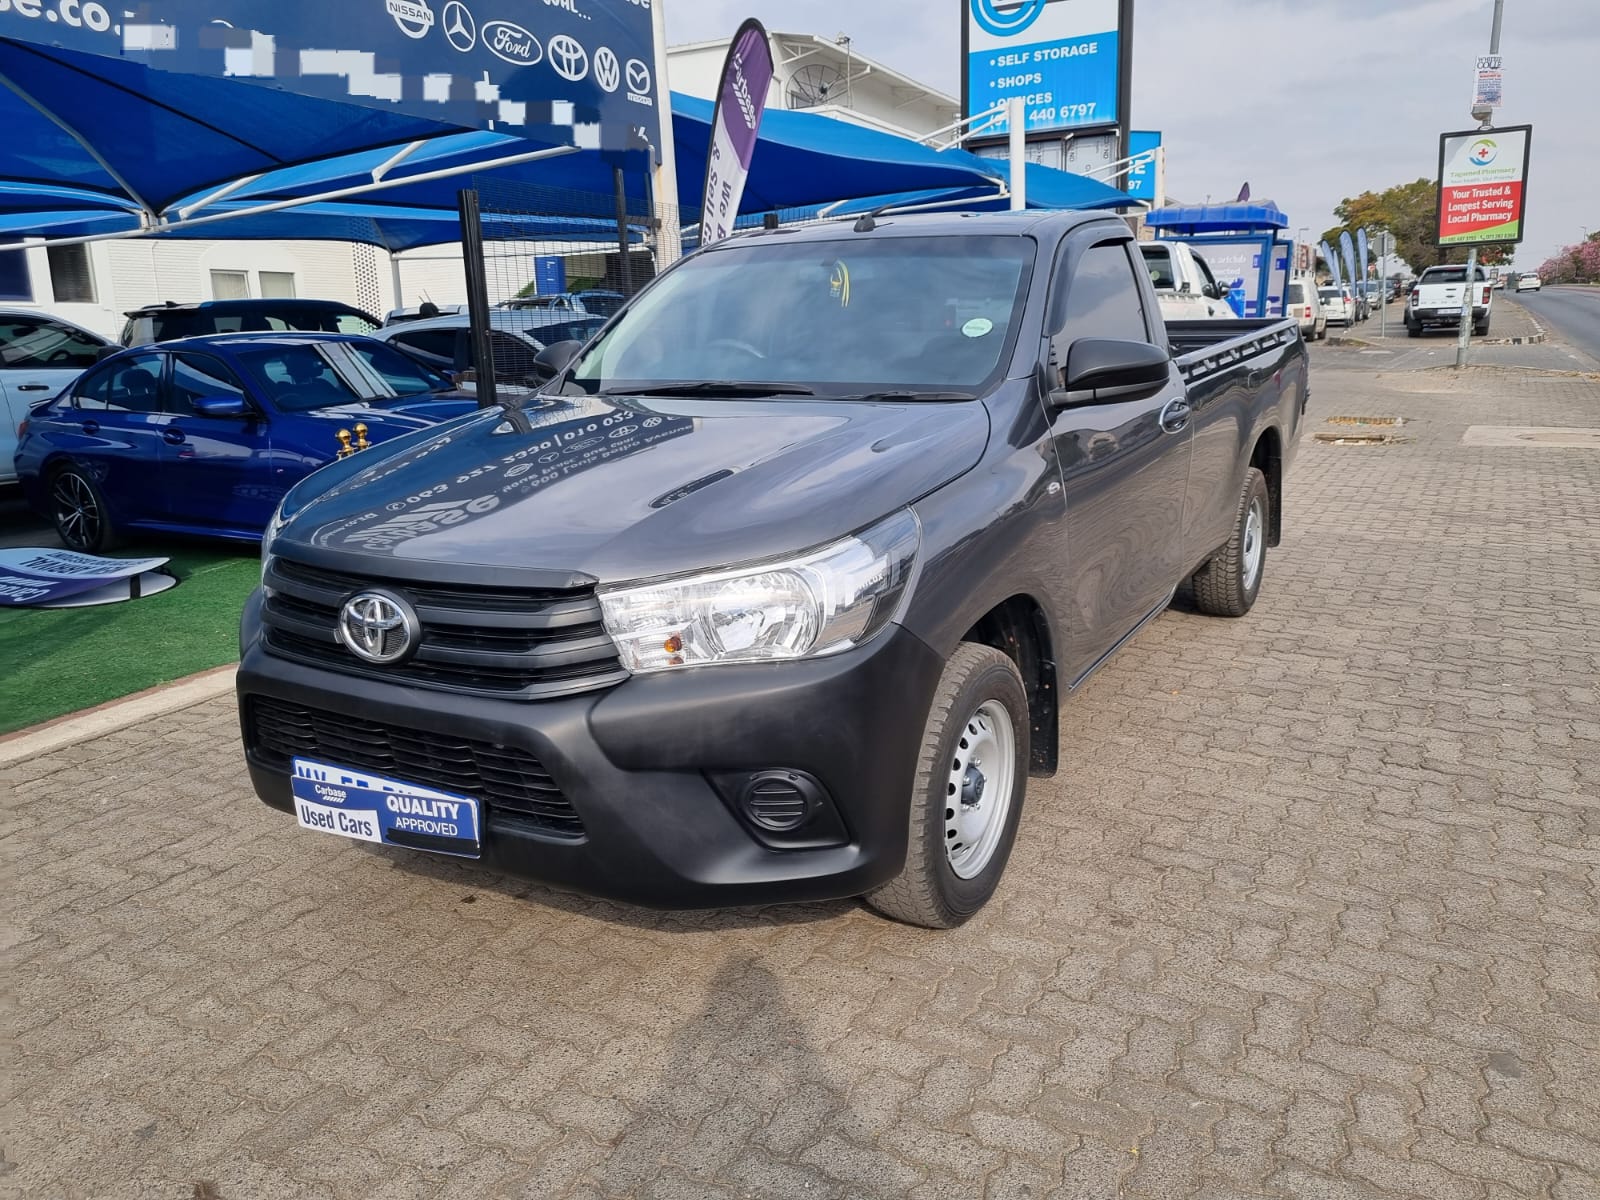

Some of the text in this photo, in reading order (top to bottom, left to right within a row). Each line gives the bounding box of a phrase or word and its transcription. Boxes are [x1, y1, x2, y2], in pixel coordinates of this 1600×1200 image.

[388, 1, 432, 22] NISSAN
[494, 26, 531, 58] Ford
[997, 42, 1098, 67] SELF STORAGE
[997, 72, 1042, 88] SHOPS
[1028, 102, 1097, 121] 440 6797
[706, 167, 718, 218] Sell
[719, 180, 732, 218] We
[1452, 185, 1511, 199] Your Trusted &
[1448, 198, 1514, 212] Longest Serving
[1447, 211, 1512, 224] Local Pharmacy
[315, 784, 347, 798] Carbase
[385, 795, 460, 820] QUALITY
[300, 804, 373, 837] Used Cars
[395, 816, 458, 836] APPROVED
